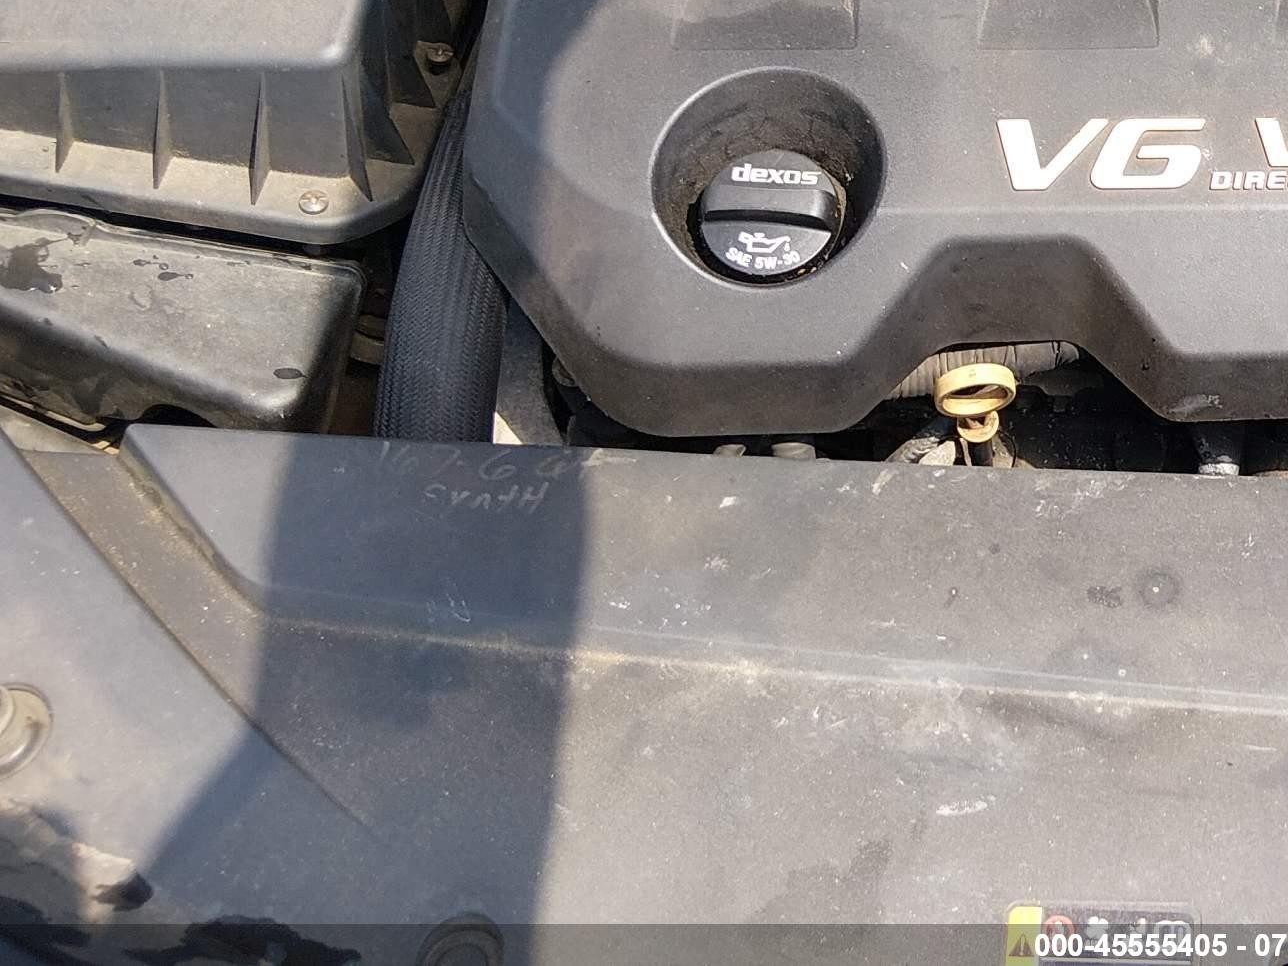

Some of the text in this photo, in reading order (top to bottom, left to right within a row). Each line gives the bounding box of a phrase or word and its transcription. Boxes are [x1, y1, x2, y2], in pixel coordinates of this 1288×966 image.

[996, 118, 1207, 191] V6
[731, 163, 822, 185] dexos
[726, 247, 801, 270] SAE 5W-30
